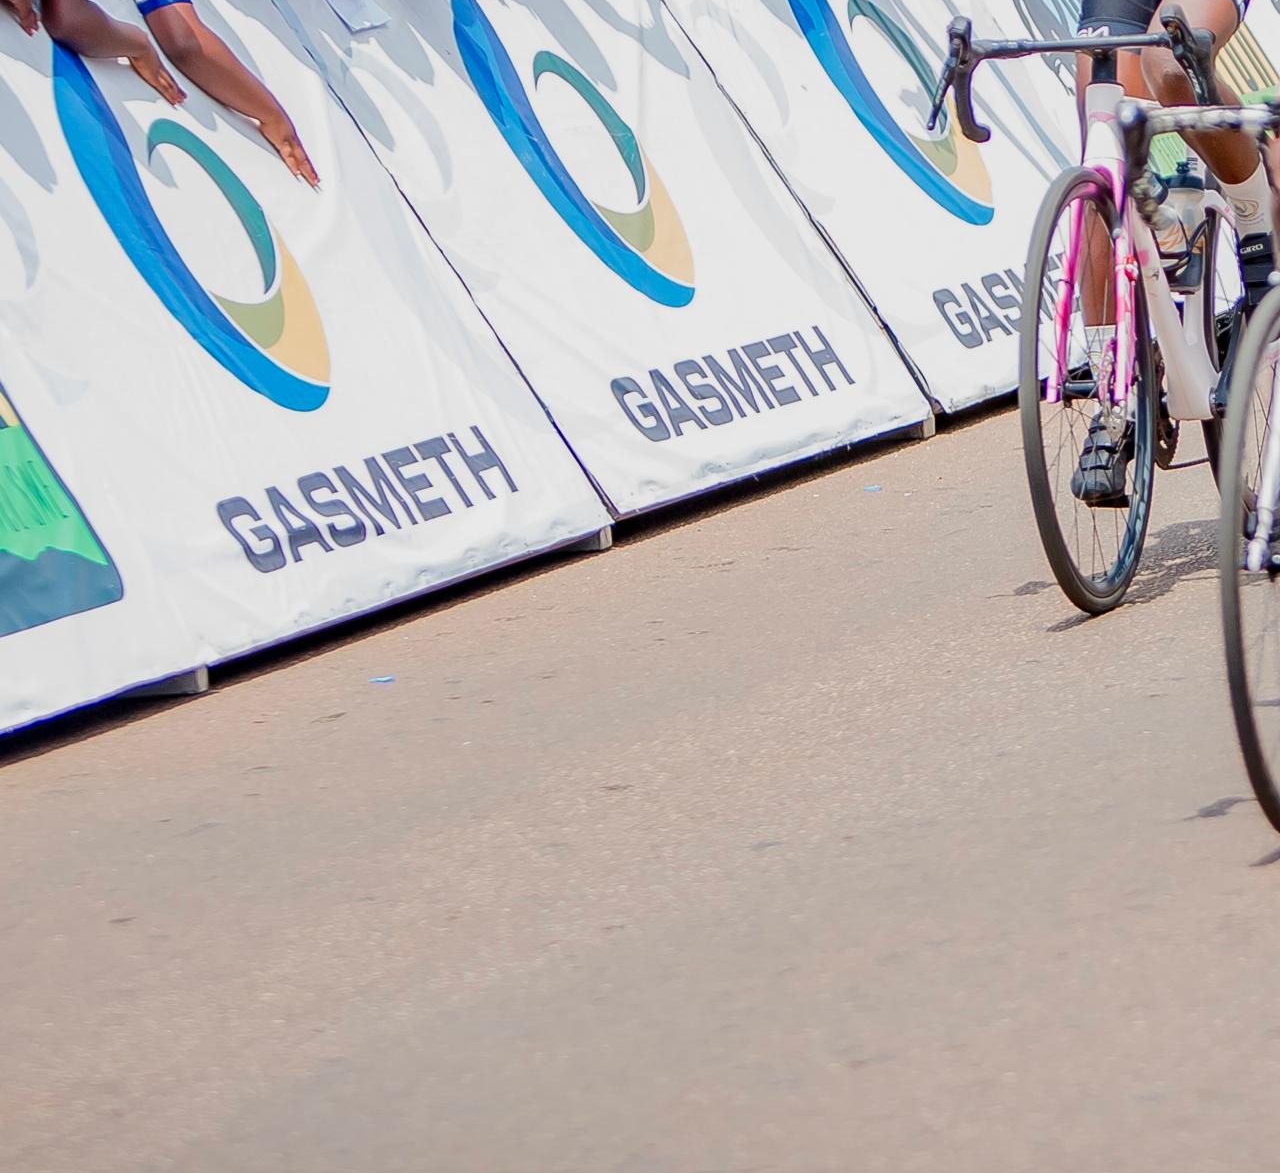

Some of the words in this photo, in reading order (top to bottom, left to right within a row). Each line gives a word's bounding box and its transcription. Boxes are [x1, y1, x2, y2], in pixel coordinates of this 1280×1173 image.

[1240, 243, 1264, 254] GIRO
[610, 325, 856, 442] GASMETH
[217, 426, 518, 574] GASMETH
